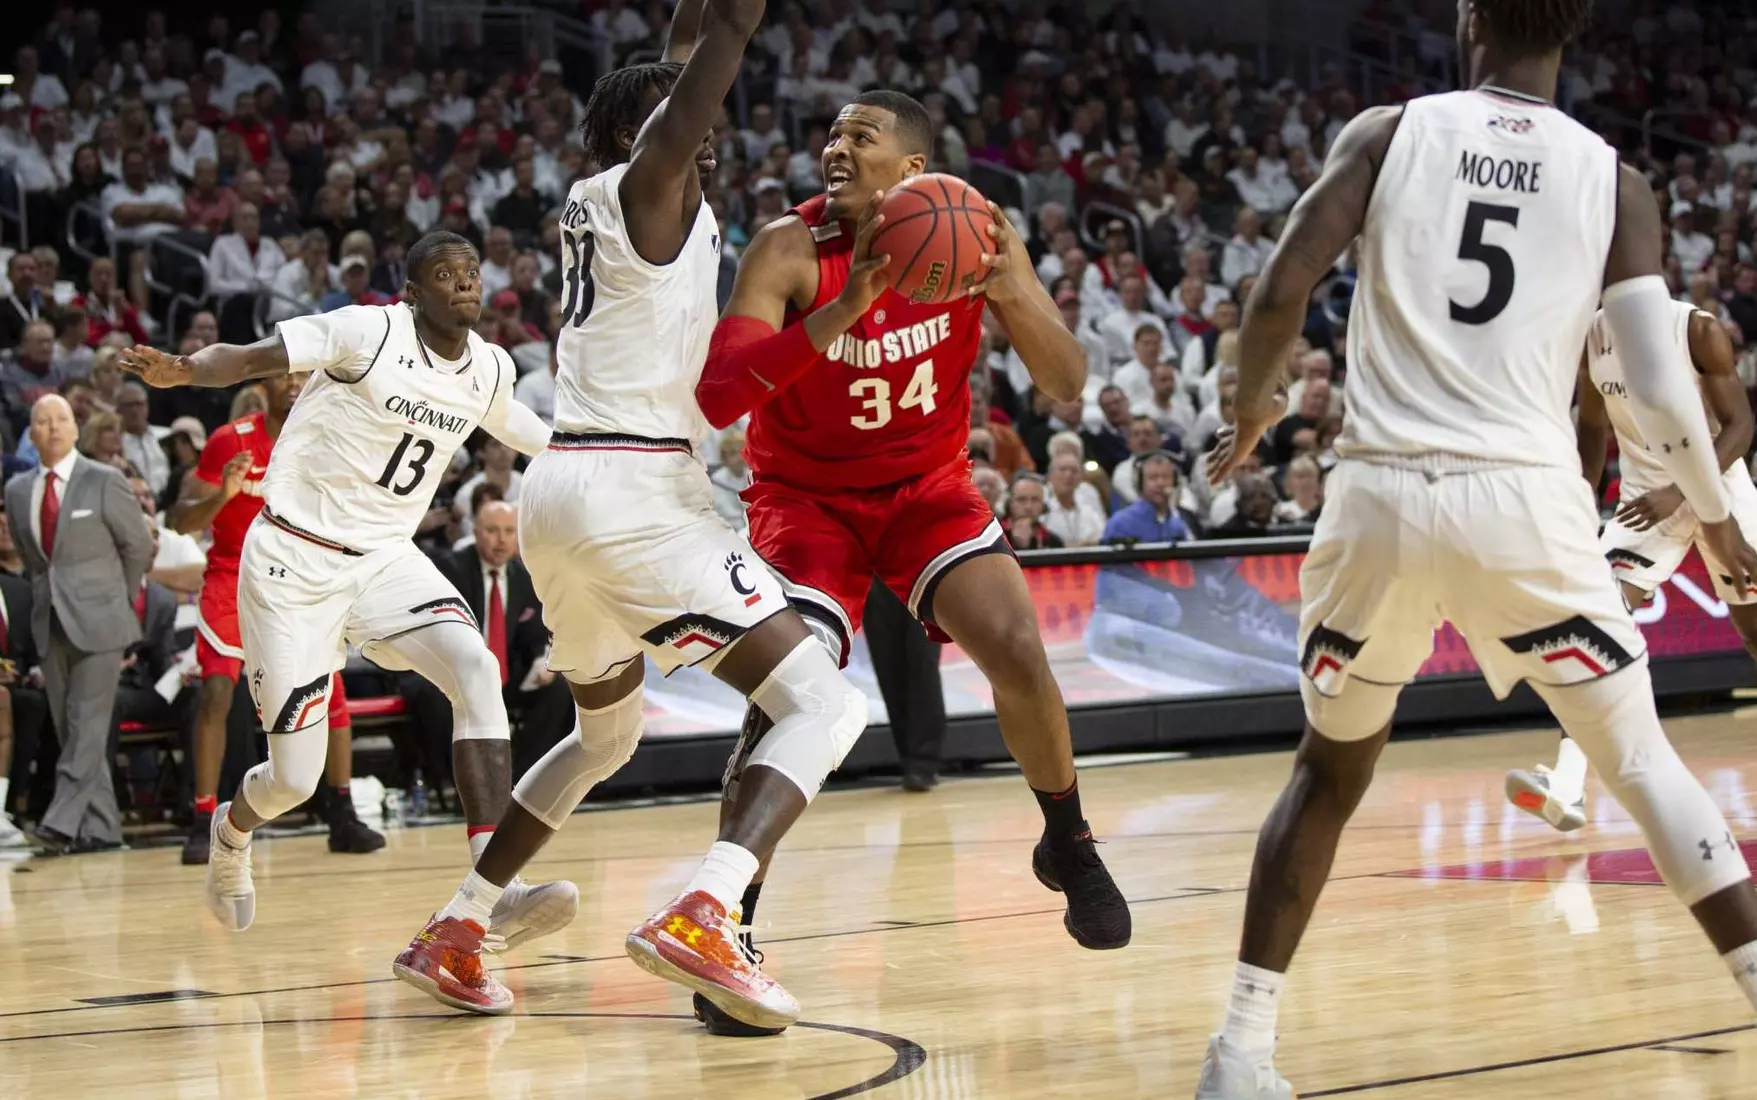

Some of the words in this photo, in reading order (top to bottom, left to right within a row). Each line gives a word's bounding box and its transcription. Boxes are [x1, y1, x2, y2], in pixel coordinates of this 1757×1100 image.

[1456, 151, 1542, 193] MOORE
[1448, 200, 1520, 326] 5
[882, 312, 951, 363] STATE
[385, 395, 469, 434] CINCINNATI
[849, 358, 938, 430] 34
[375, 432, 435, 495] 13
